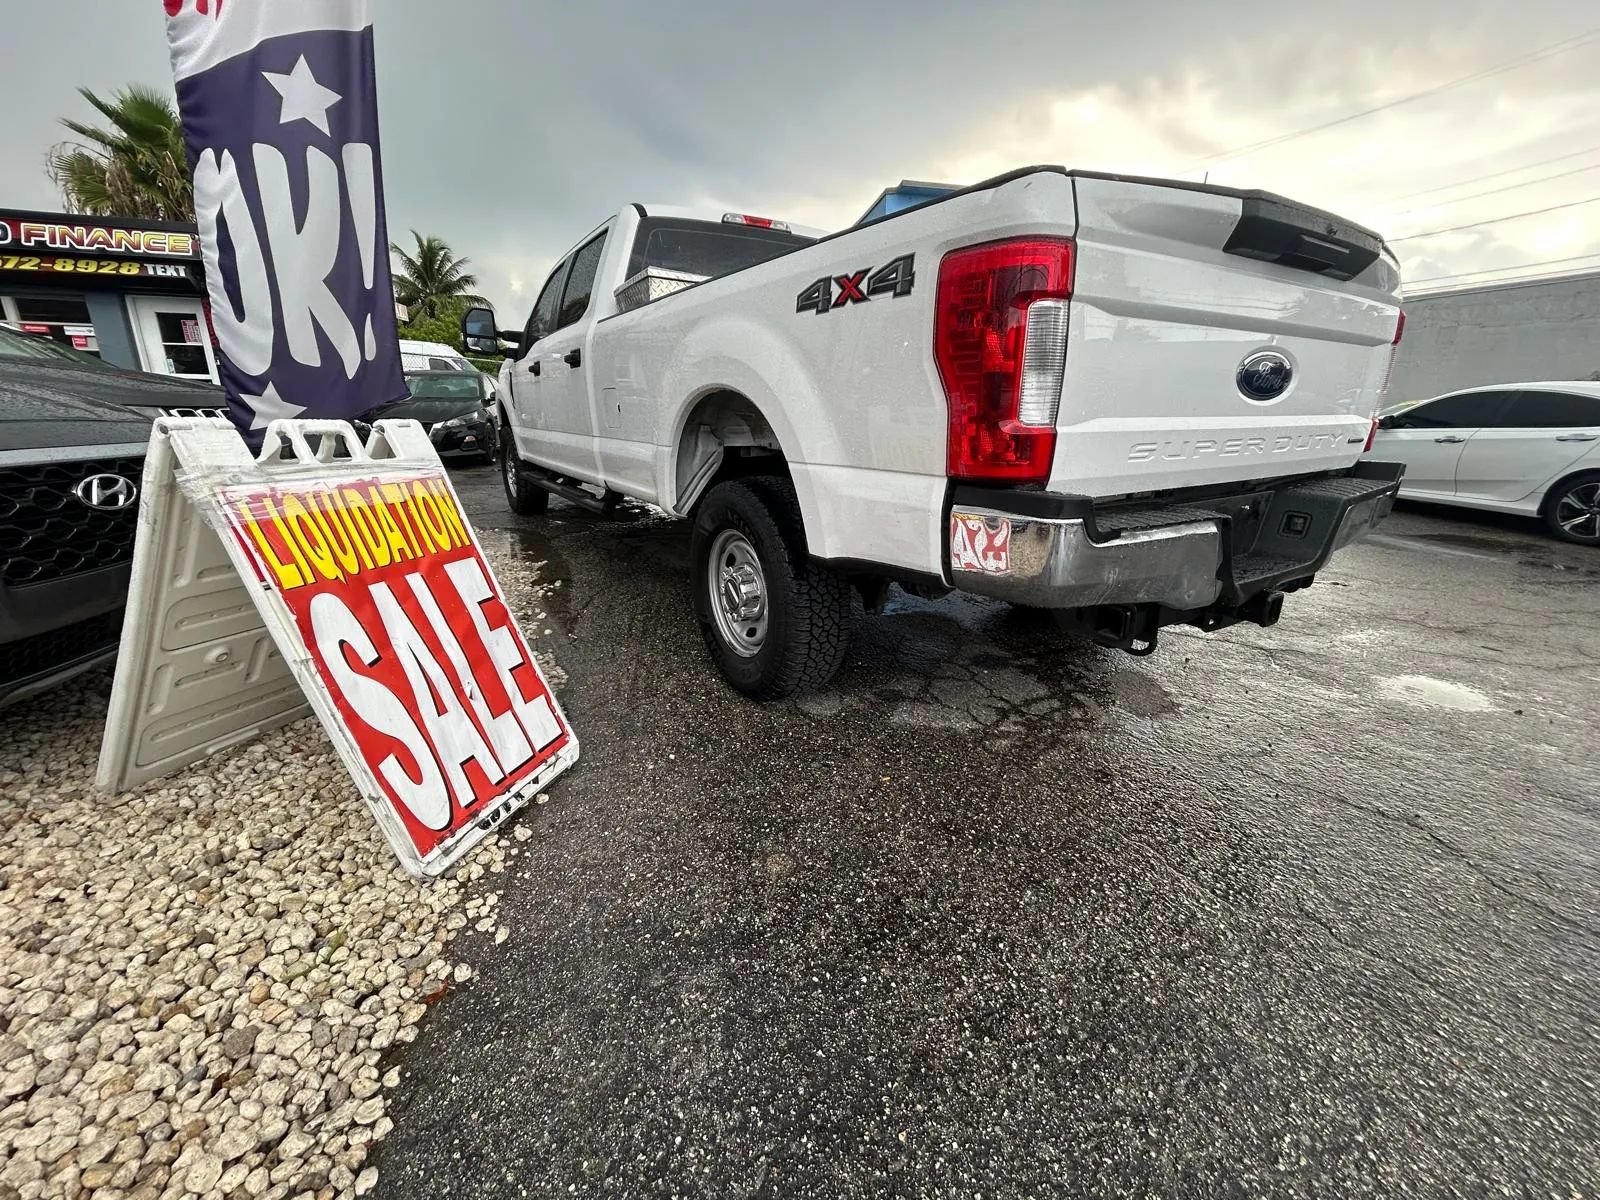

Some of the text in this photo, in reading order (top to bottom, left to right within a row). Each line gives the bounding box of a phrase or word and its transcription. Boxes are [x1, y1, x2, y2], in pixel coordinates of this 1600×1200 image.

[0, 255, 187, 277] 72-8928 TEXT
[20, 222, 193, 256] FINANCE
[193, 142, 377, 380] OK!
[1127, 432, 1344, 463] SUPER DUTY
[238, 478, 472, 591] LIQUIDATION
[309, 557, 564, 832] SALE
